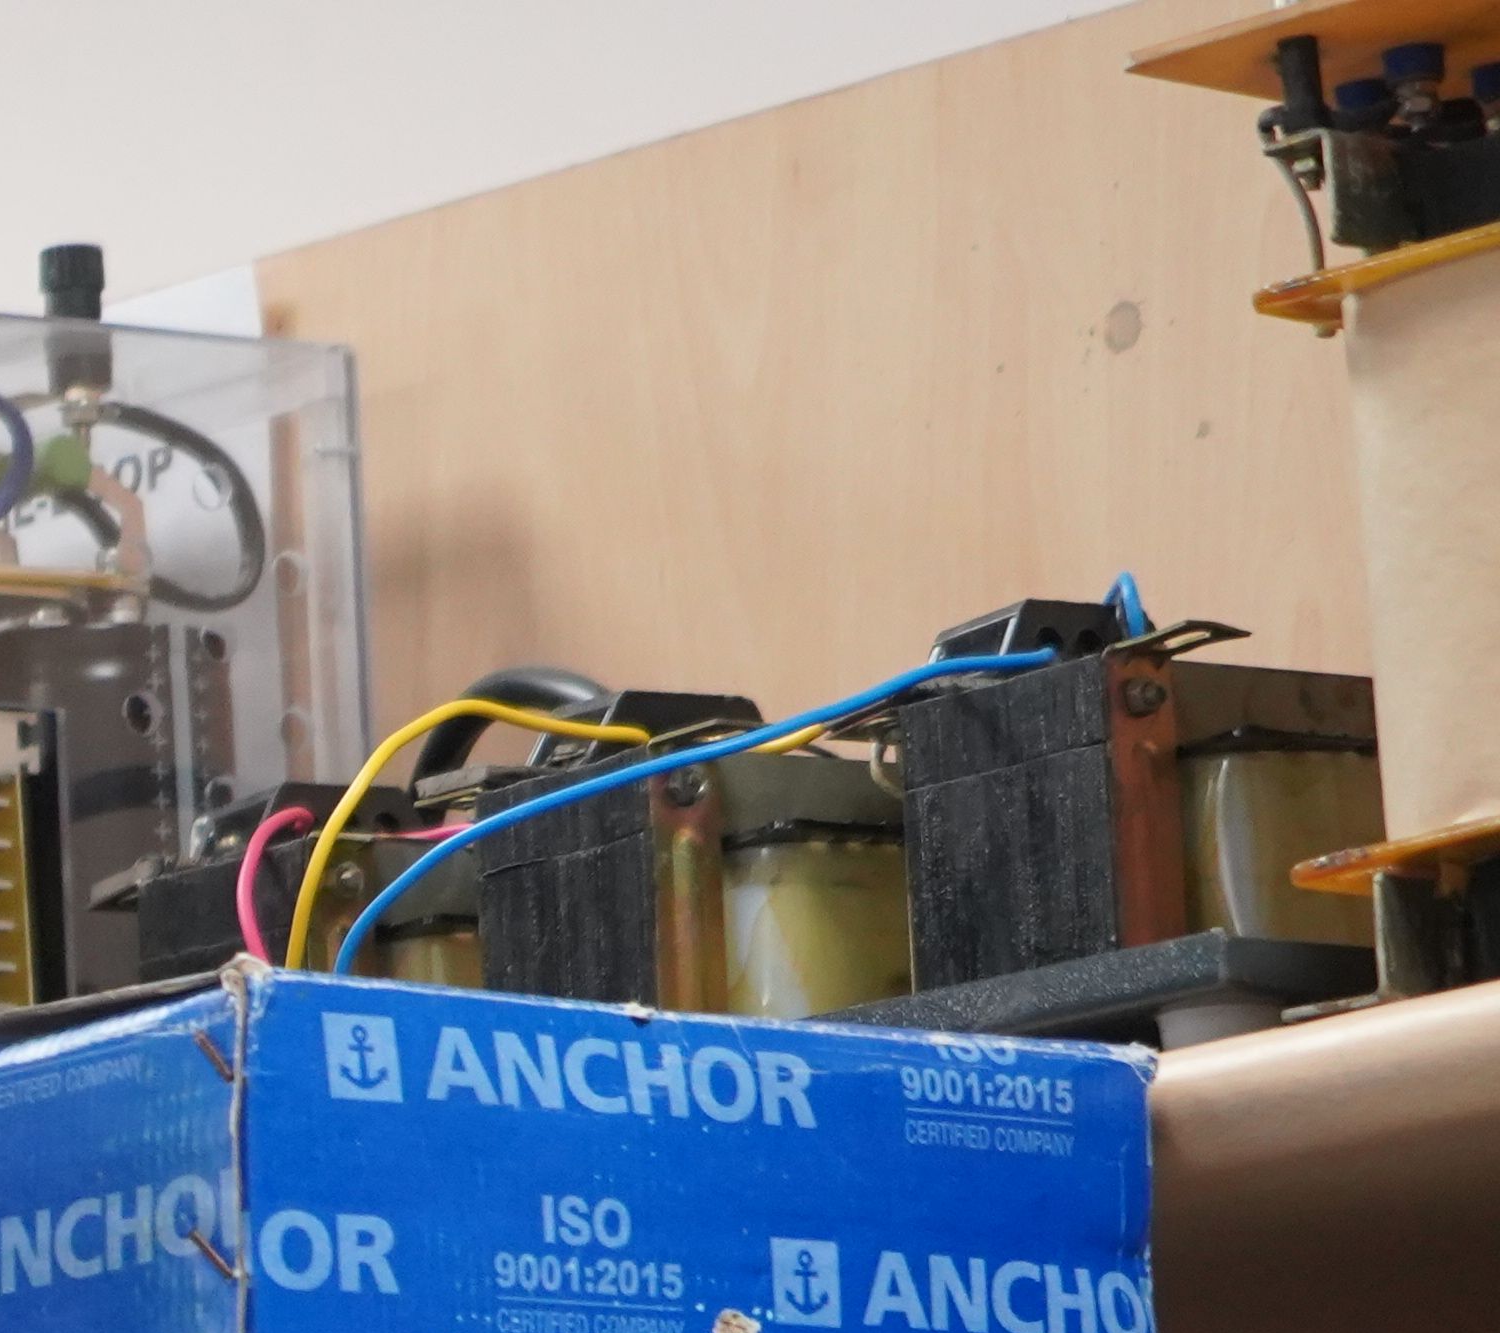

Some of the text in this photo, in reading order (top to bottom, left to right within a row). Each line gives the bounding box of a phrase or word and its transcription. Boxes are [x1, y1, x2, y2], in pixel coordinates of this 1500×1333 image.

[427, 1026, 817, 1128] ANCHOR
[901, 1066, 1075, 1114] 9001:2015
[905, 1119, 1076, 1156] CERTIFIED COMPANY
[541, 1194, 632, 1248] ISO
[495, 1252, 684, 1299] 9001:2015
